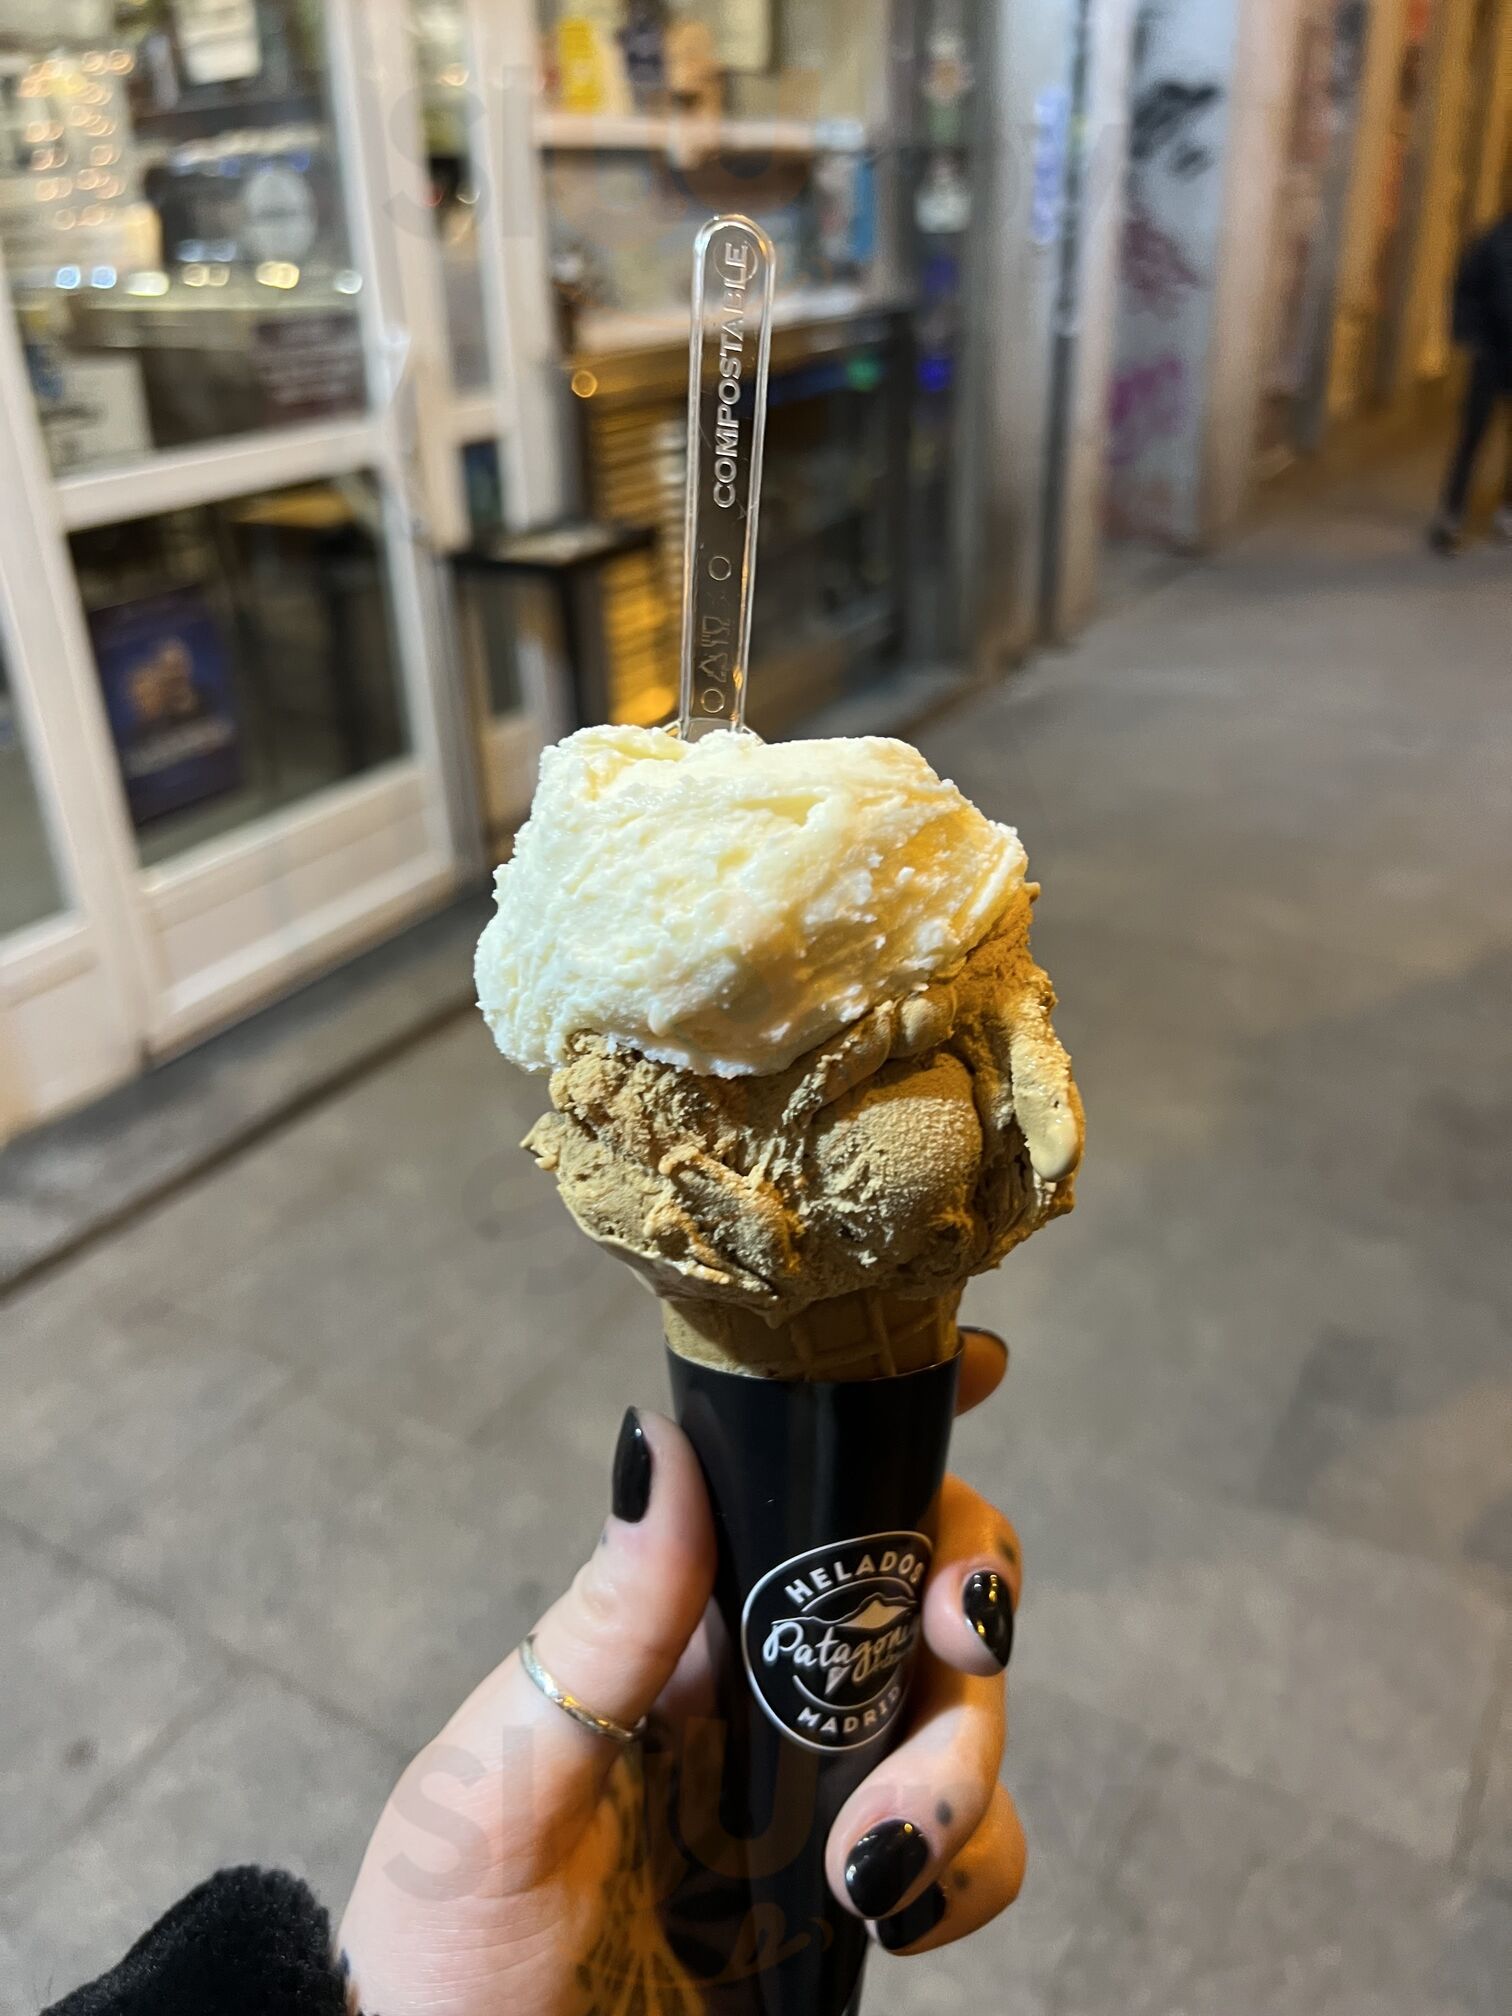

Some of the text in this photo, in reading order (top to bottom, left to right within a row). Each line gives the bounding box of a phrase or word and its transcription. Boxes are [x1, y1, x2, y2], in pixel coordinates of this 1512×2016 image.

[712, 240, 750, 510] COMPOSTABLE
[784, 1550, 926, 1604] HELADOS
[797, 1685, 902, 1735] MADRID
